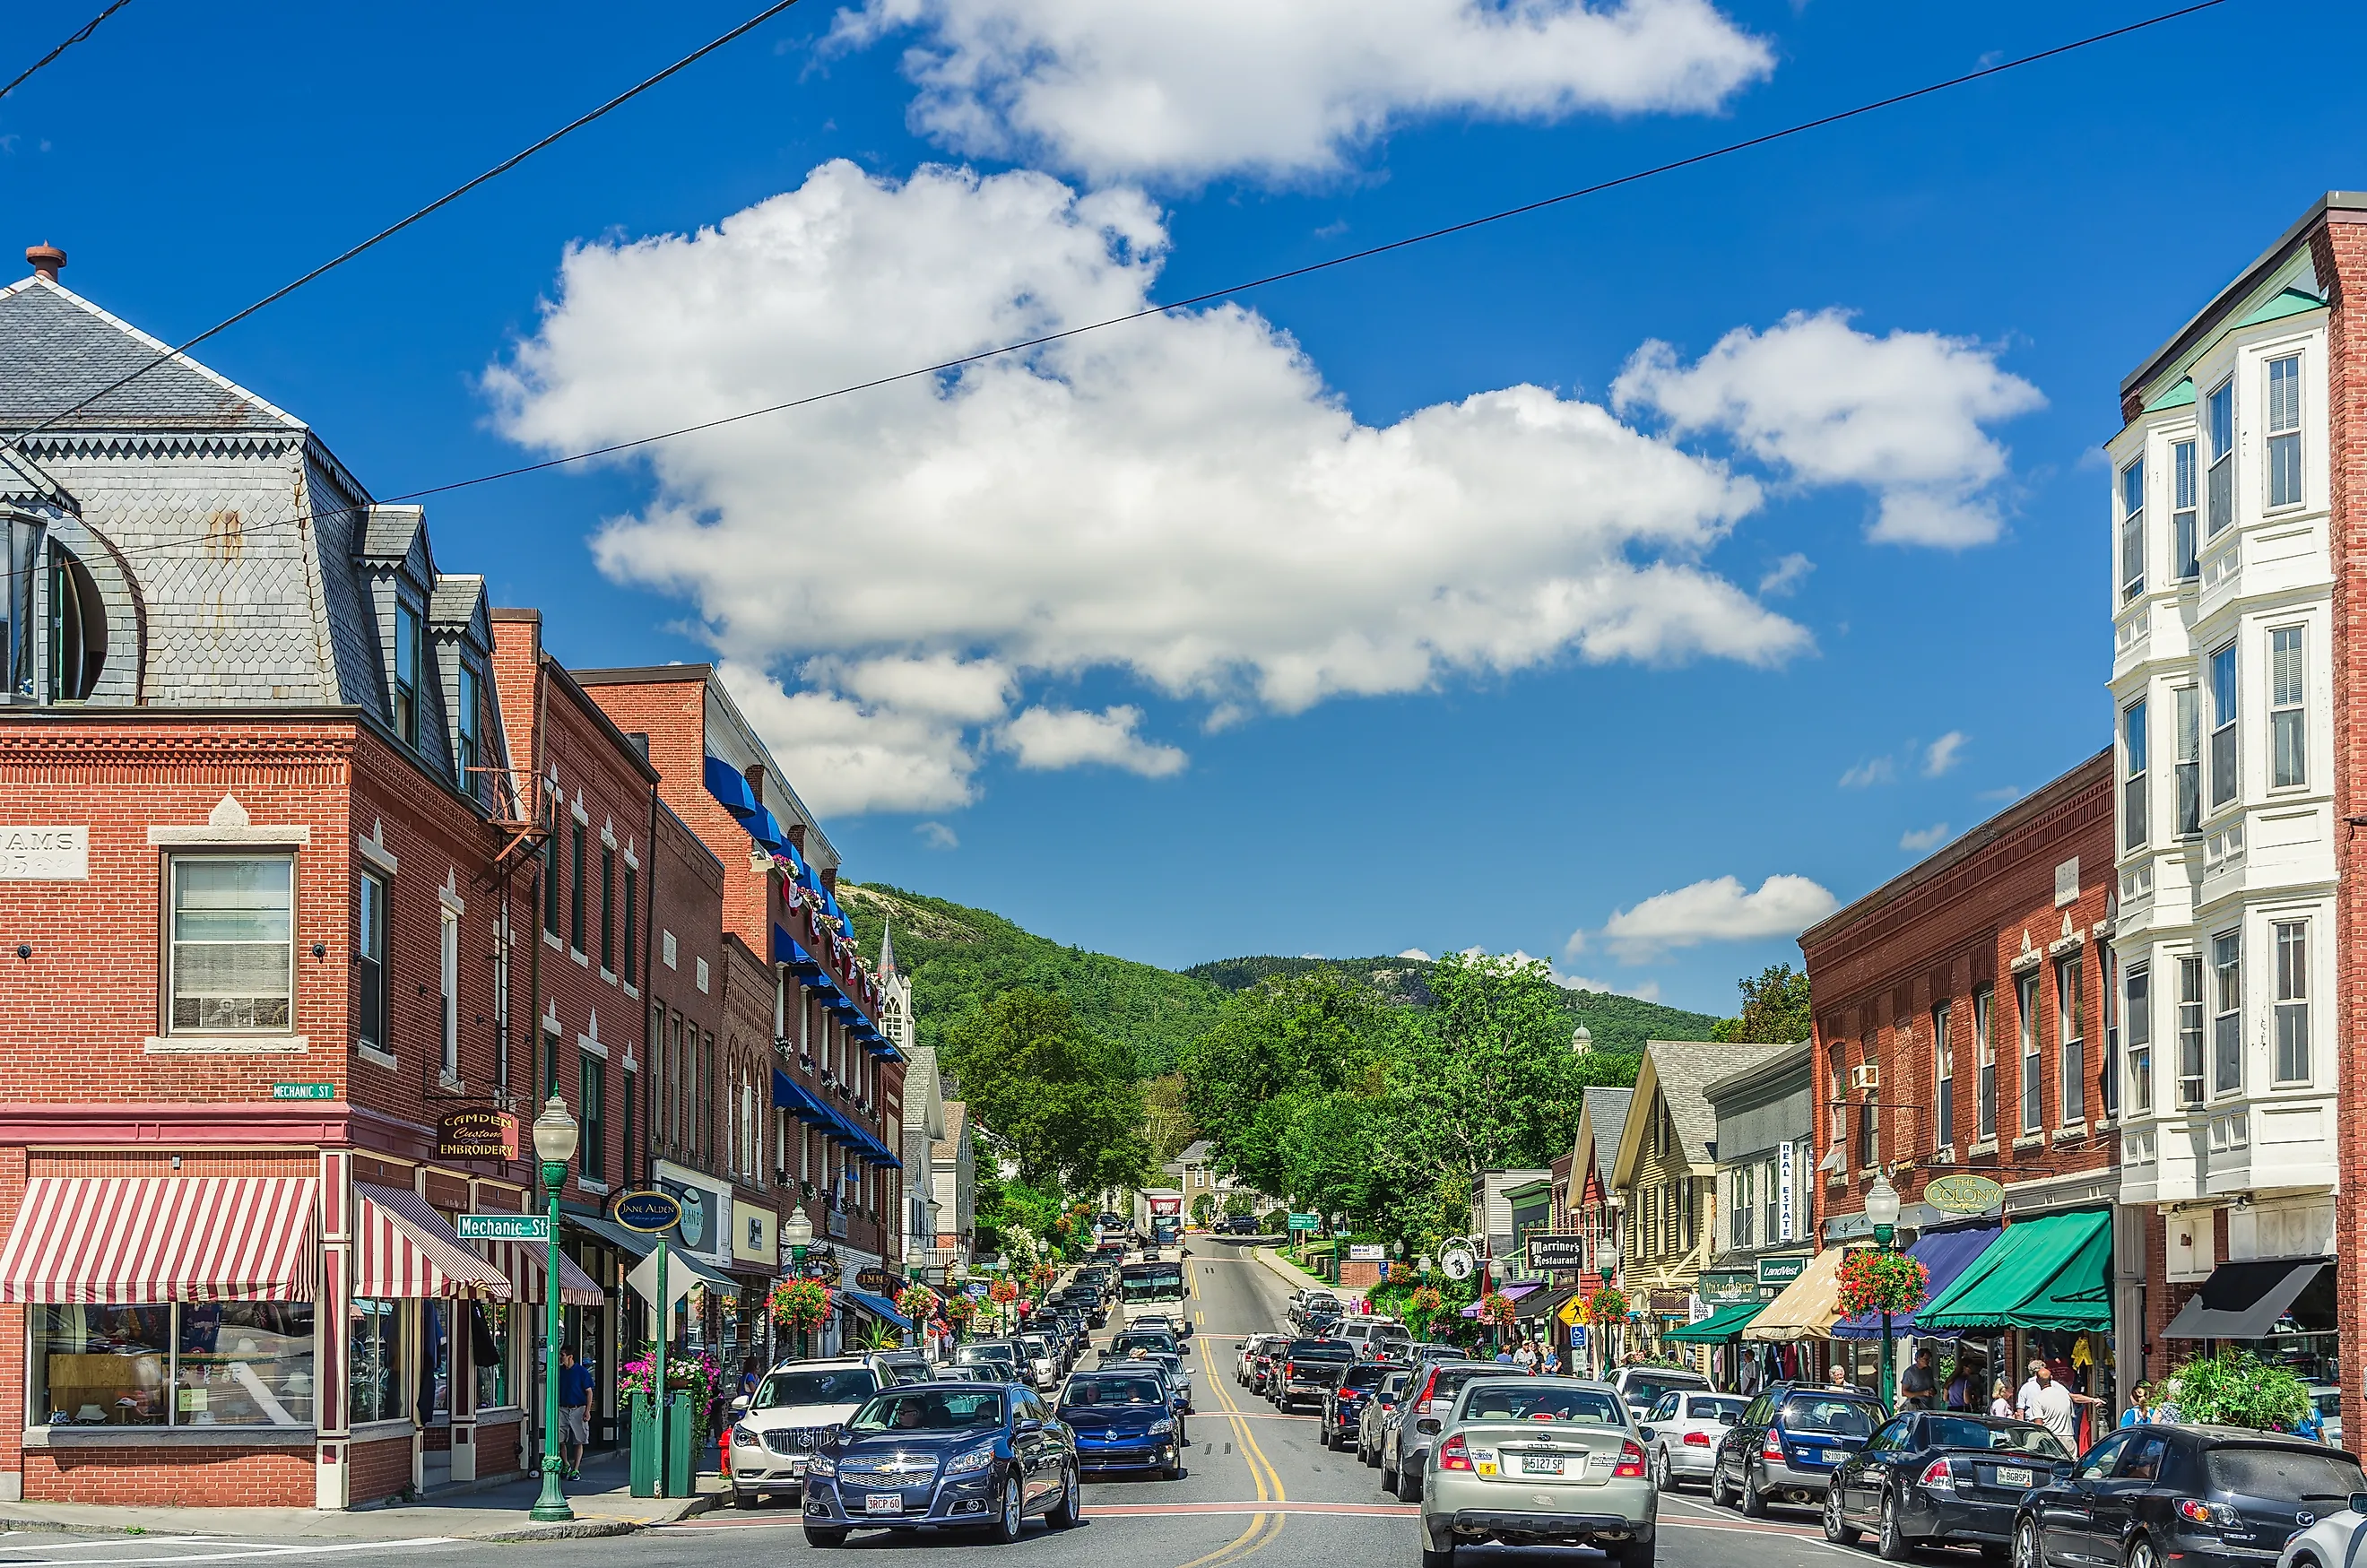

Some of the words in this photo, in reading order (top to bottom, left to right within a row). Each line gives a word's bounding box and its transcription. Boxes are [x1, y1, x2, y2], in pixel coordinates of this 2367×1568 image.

[0, 834, 82, 850] AMS.
[273, 1085, 314, 1097] MECHANIC
[318, 1085, 330, 1097] ST
[444, 1113, 513, 1129] CAMDEN
[453, 1127, 503, 1139] Custom
[440, 1144, 514, 1157] EMBROIDERY
[1782, 1144, 1790, 1176] REAL
[1954, 1178, 1976, 1187] THE
[1929, 1186, 2001, 1202] COLONY
[1782, 1187, 1790, 1235] ESTATE
[462, 1217, 523, 1235] Mechanic
[532, 1219, 546, 1235] St
[1530, 1241, 1581, 1255] Marriner's
[1533, 1255, 1579, 1267] Restaurant
[1763, 1265, 1799, 1277] LandVest
[862, 1274, 884, 1284] INN
[1530, 1458, 1549, 1469] 5127
[1552, 1459, 1563, 1469] SP
[867, 1499, 889, 1509] 3RCP
[889, 1498, 900, 1508] 60
